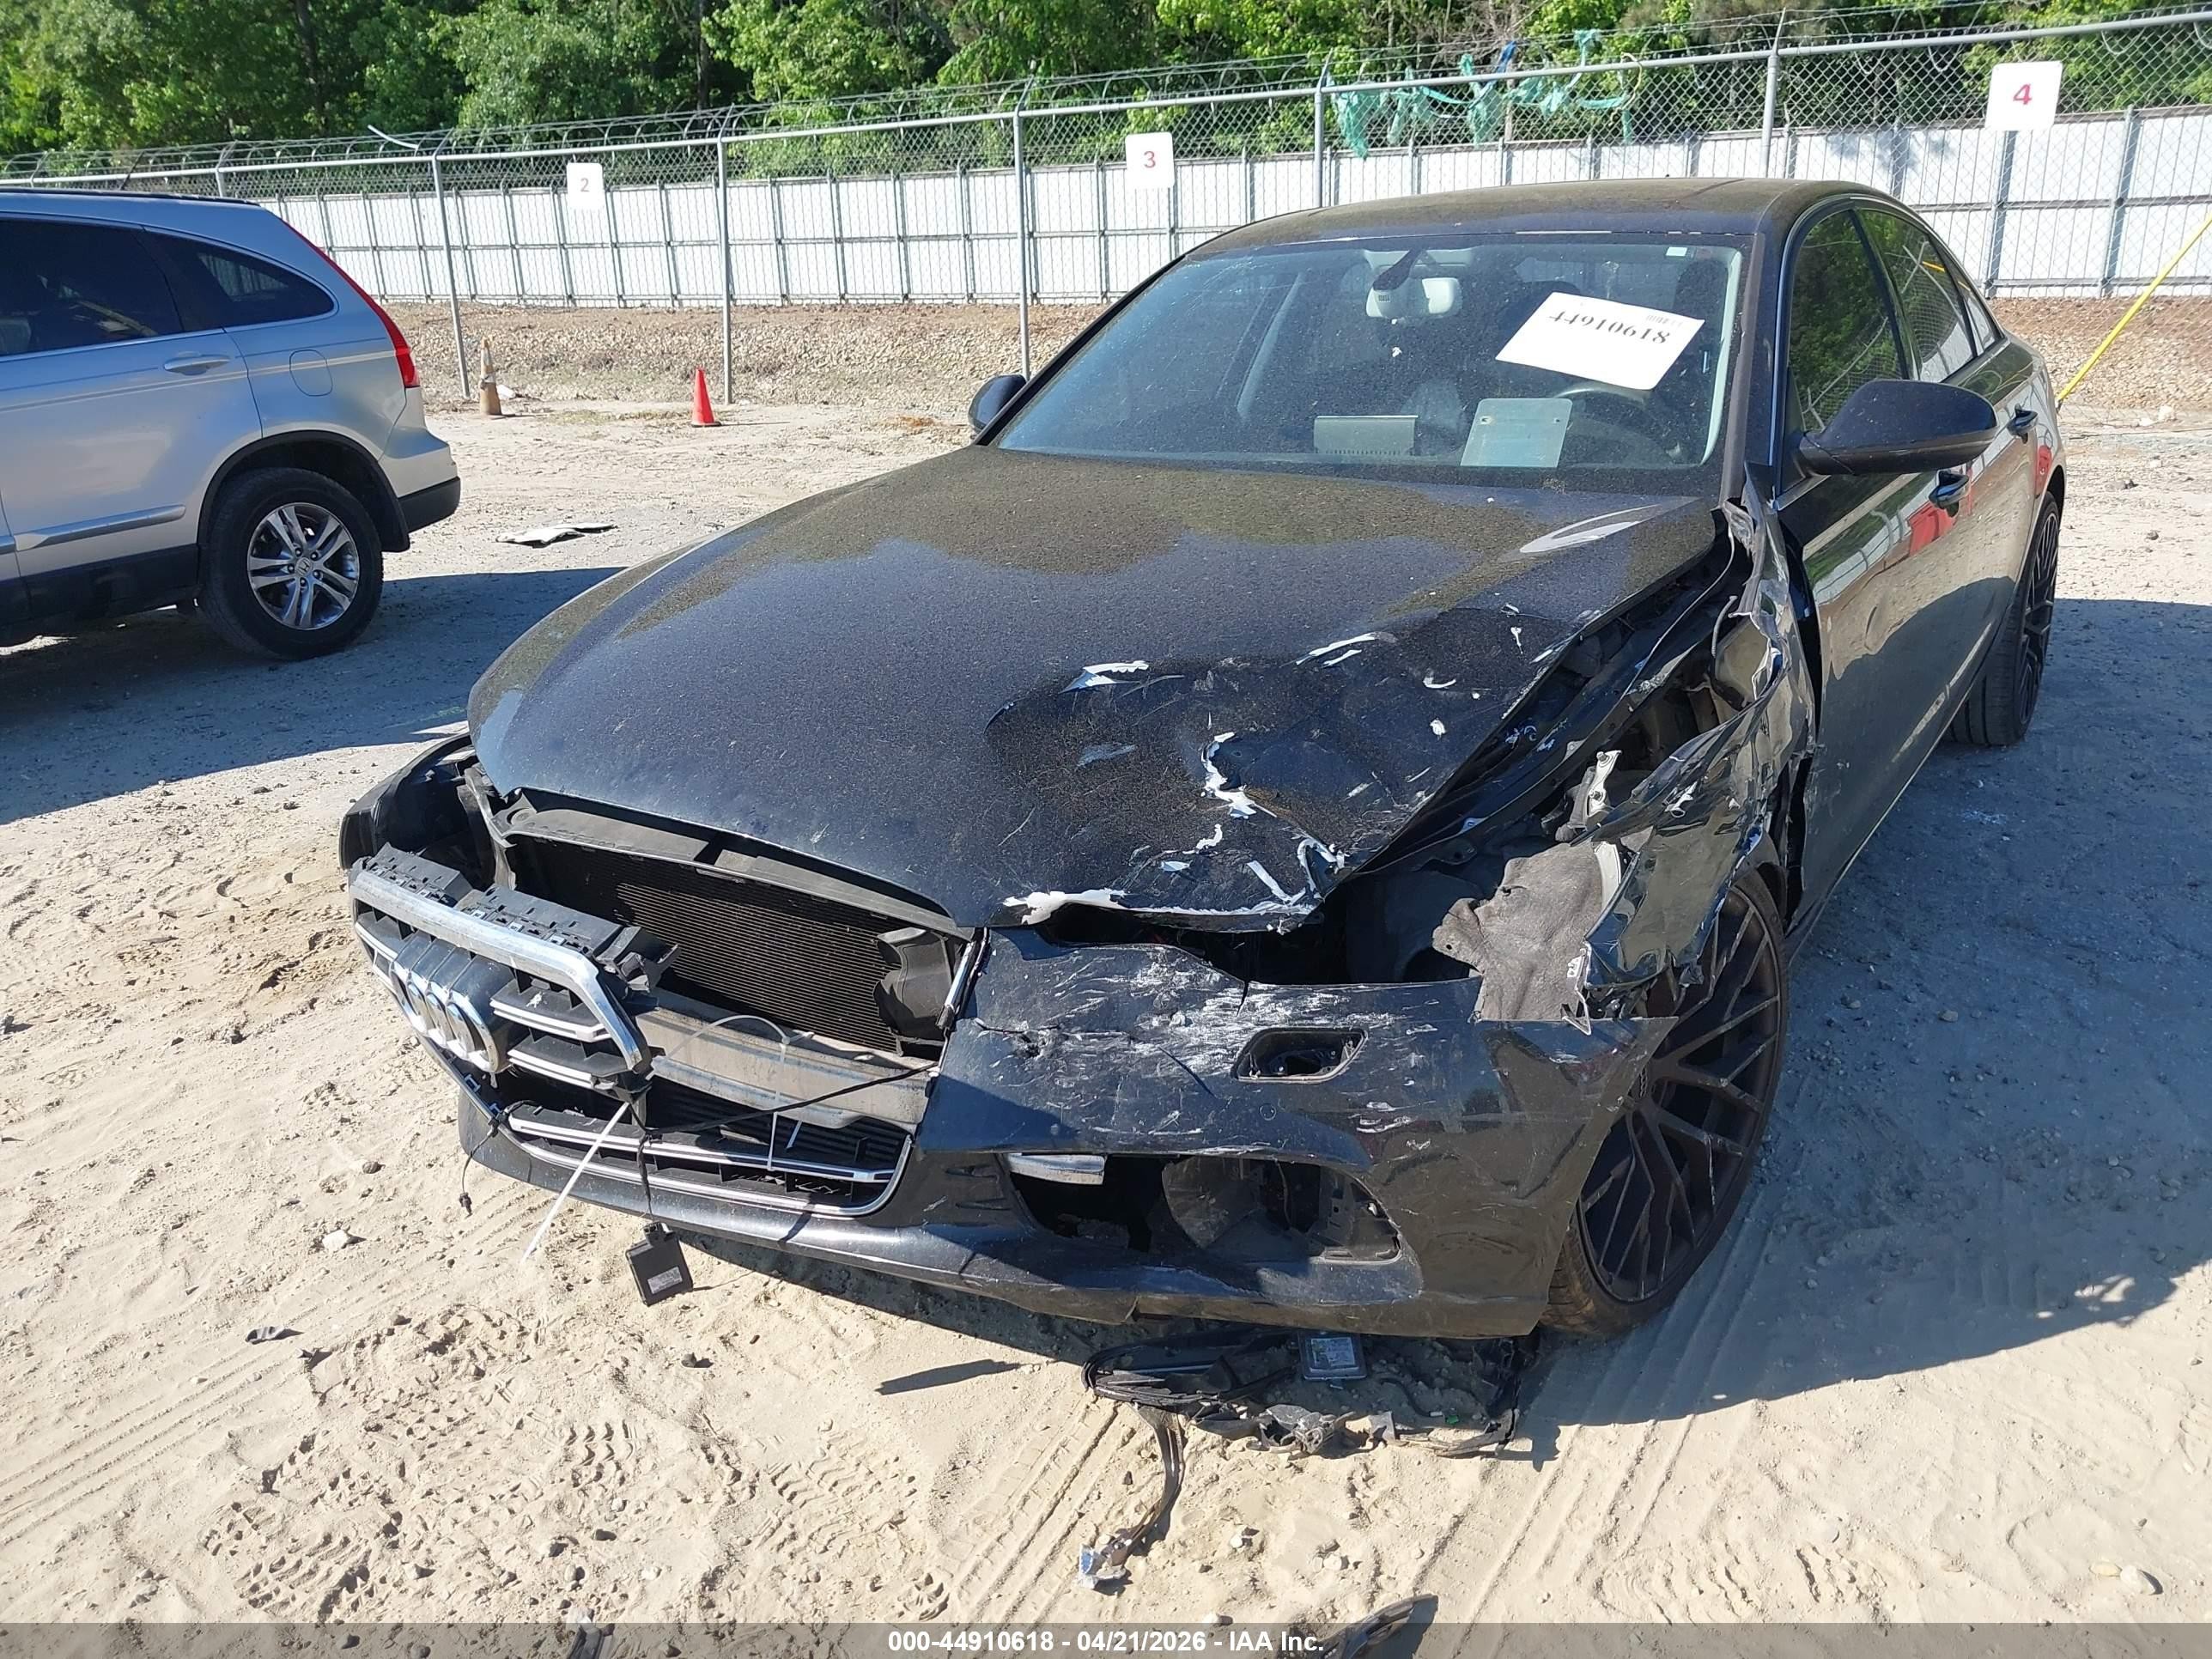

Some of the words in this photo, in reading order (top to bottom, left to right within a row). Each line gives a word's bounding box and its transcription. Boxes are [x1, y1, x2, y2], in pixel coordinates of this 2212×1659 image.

[2013, 83, 2033, 105] 4
[1144, 150, 1156, 168] 3
[580, 178, 590, 192] 2
[1549, 311, 1670, 343] 44910618
